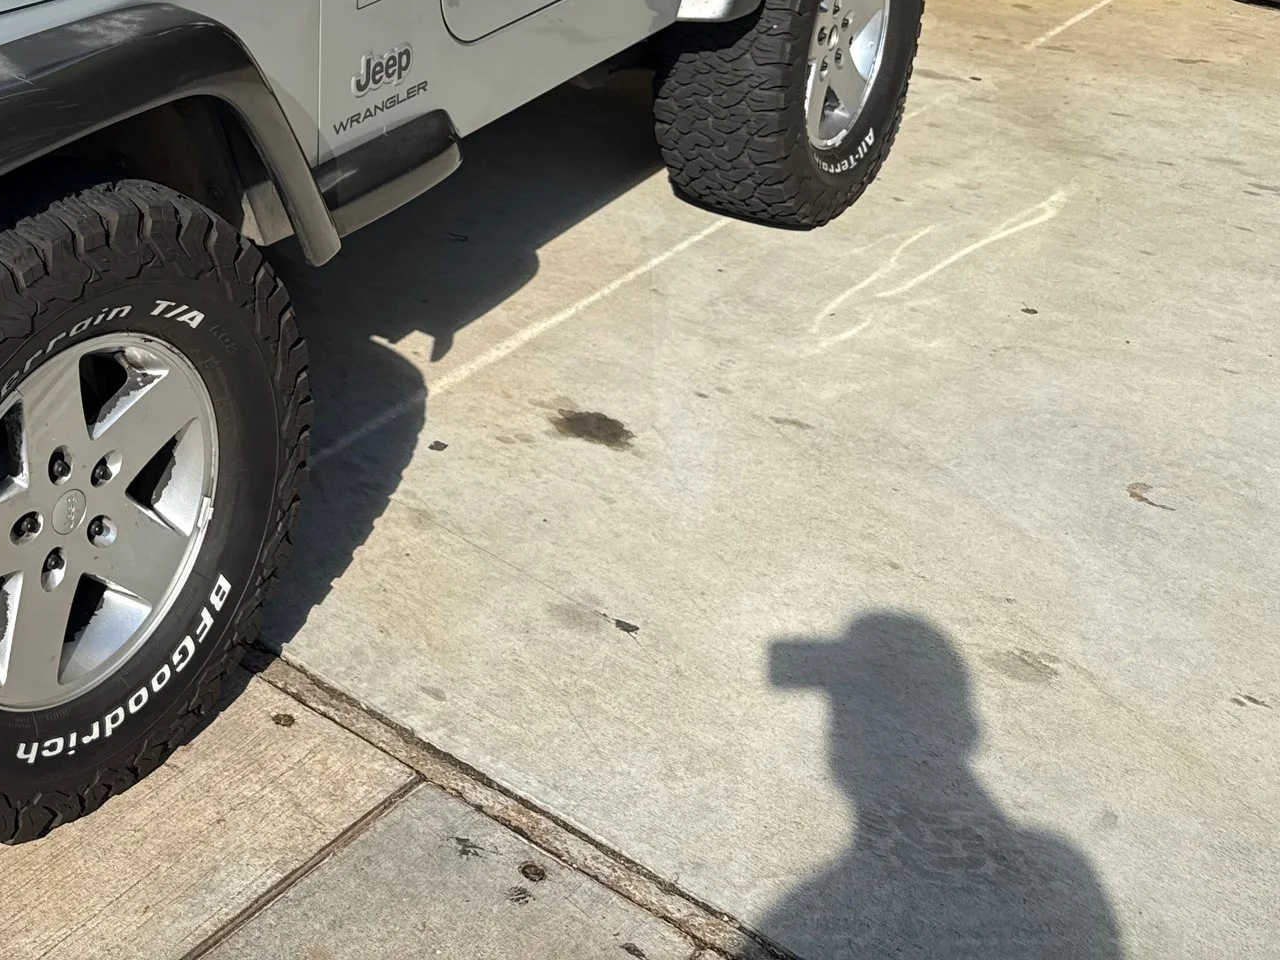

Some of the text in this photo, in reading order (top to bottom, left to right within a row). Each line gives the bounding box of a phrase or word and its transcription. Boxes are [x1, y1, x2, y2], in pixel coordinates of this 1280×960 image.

[355, 46, 412, 93] Jeep
[332, 80, 429, 136] WRANGLER
[150, 298, 206, 330] T/A
[15, 573, 232, 764] BFGoodrich
